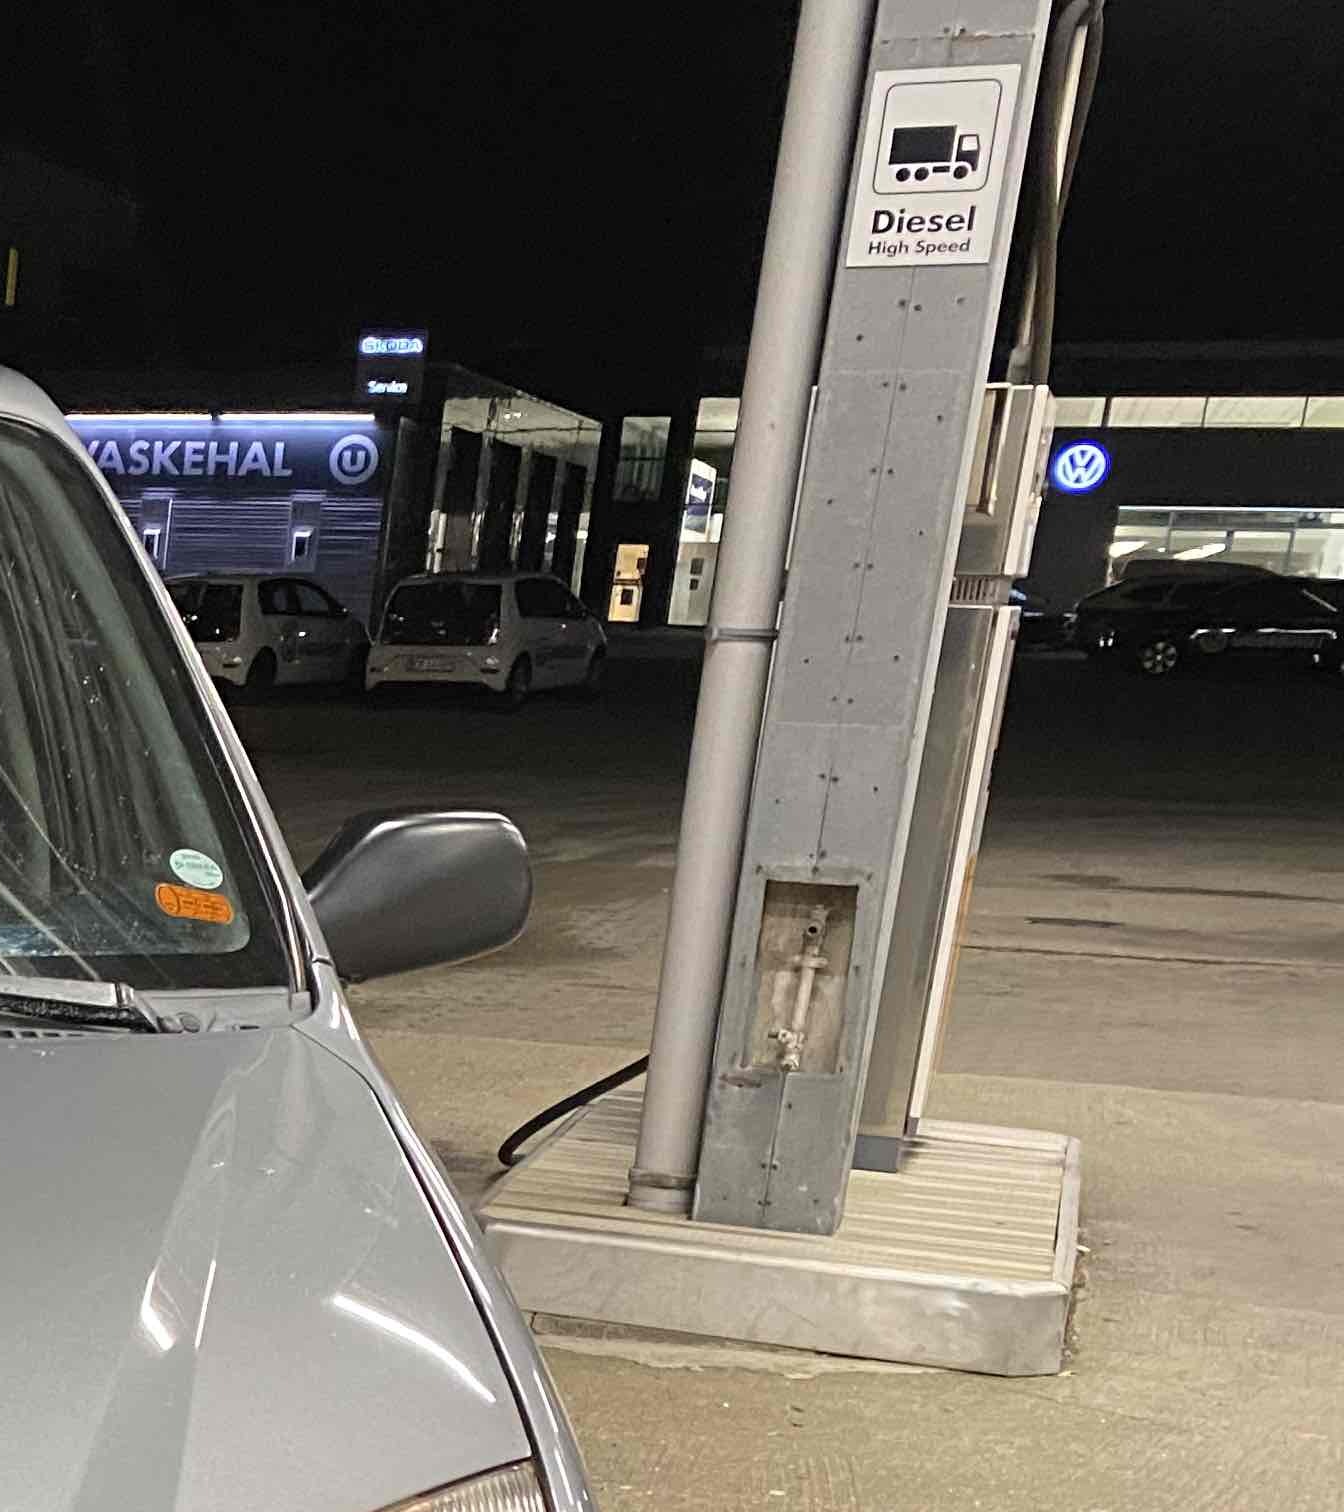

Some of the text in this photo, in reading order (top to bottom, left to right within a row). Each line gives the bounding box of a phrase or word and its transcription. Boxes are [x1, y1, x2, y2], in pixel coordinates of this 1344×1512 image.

[872, 205, 976, 234] Diesel
[868, 238, 971, 257] High Speed
